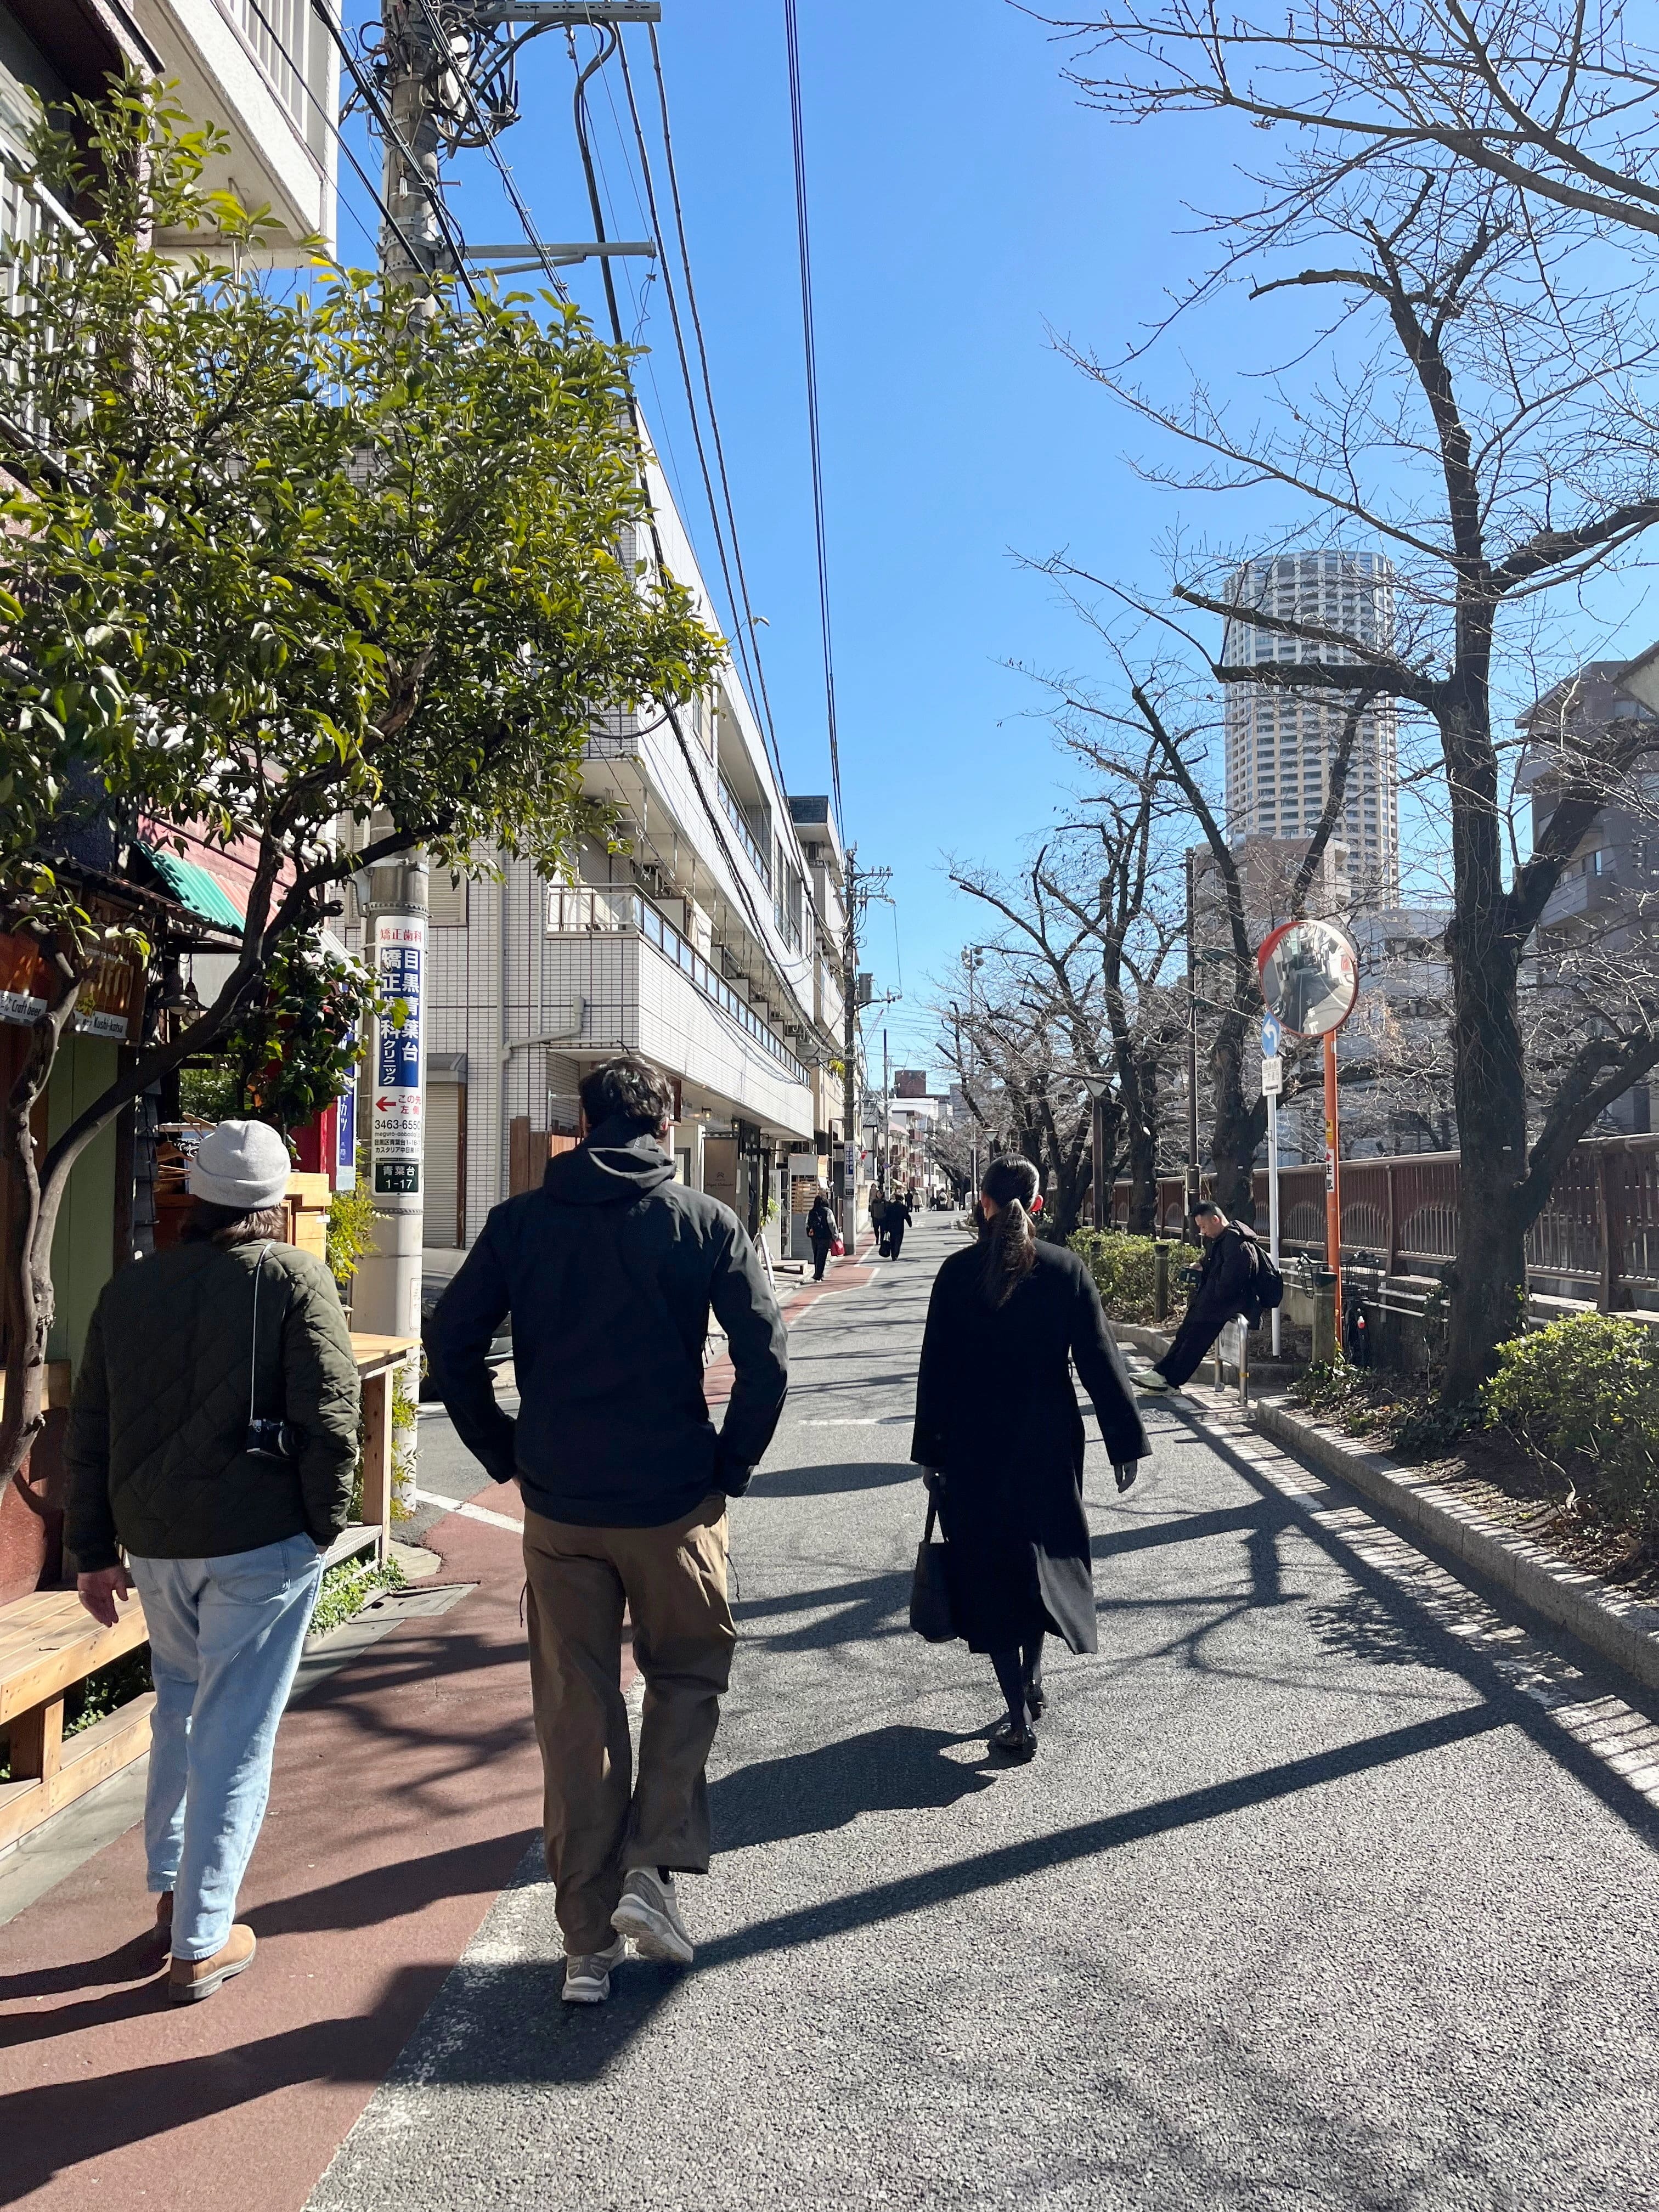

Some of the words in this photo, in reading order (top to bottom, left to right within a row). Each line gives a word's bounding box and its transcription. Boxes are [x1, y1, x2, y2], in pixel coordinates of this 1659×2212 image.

[380, 928, 422, 943] 矯正歯科
[12, 1000, 27, 1014] Craft
[27, 1002, 41, 1016] beer
[402, 950, 419, 1062] 目黒青葉台
[398, 1094, 421, 1104] この先
[375, 1120, 421, 1130] 3463-6550
[383, 1166, 415, 1176] 青葉台
[386, 1179, 413, 1189] 1-17
